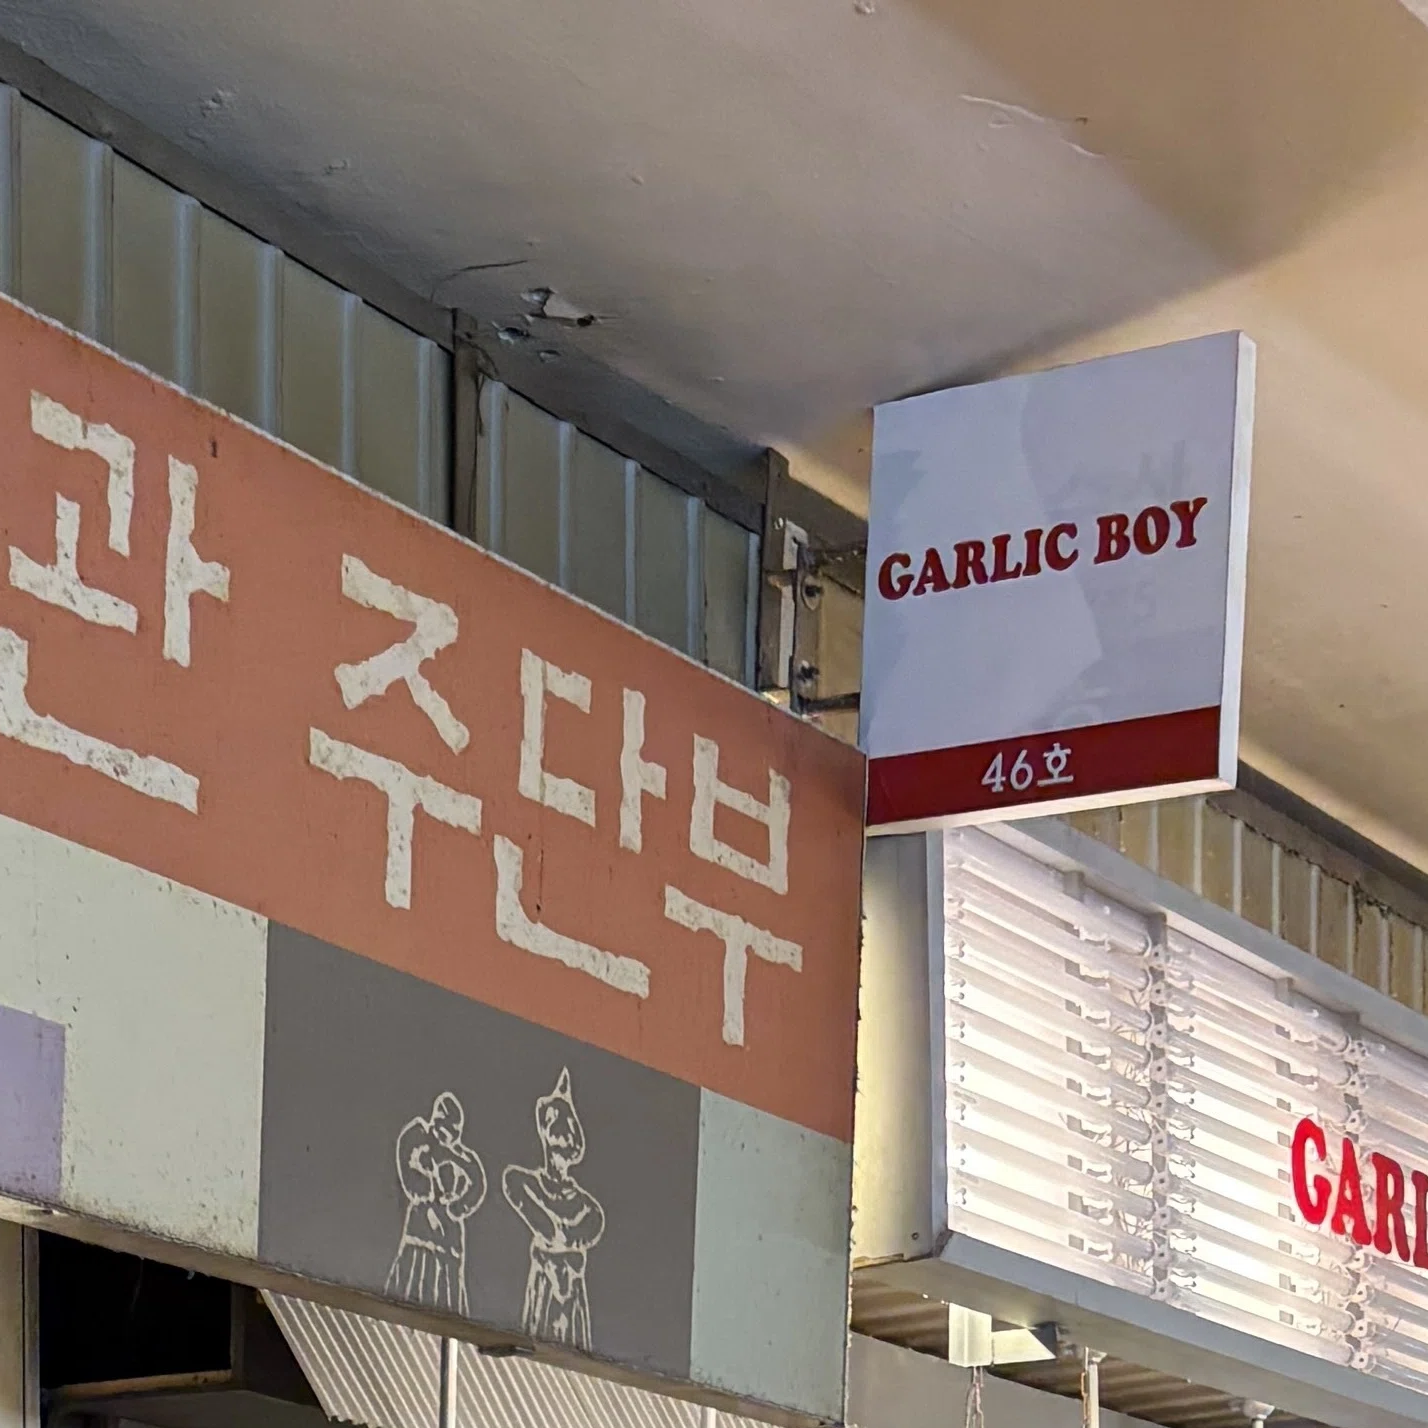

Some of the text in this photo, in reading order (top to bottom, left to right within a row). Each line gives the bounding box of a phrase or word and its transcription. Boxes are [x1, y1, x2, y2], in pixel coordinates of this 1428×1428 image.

[878, 497, 1208, 600] GARLIC BOY
[309, 551, 803, 1047] 주단부
[981, 742, 1074, 792] 46호
